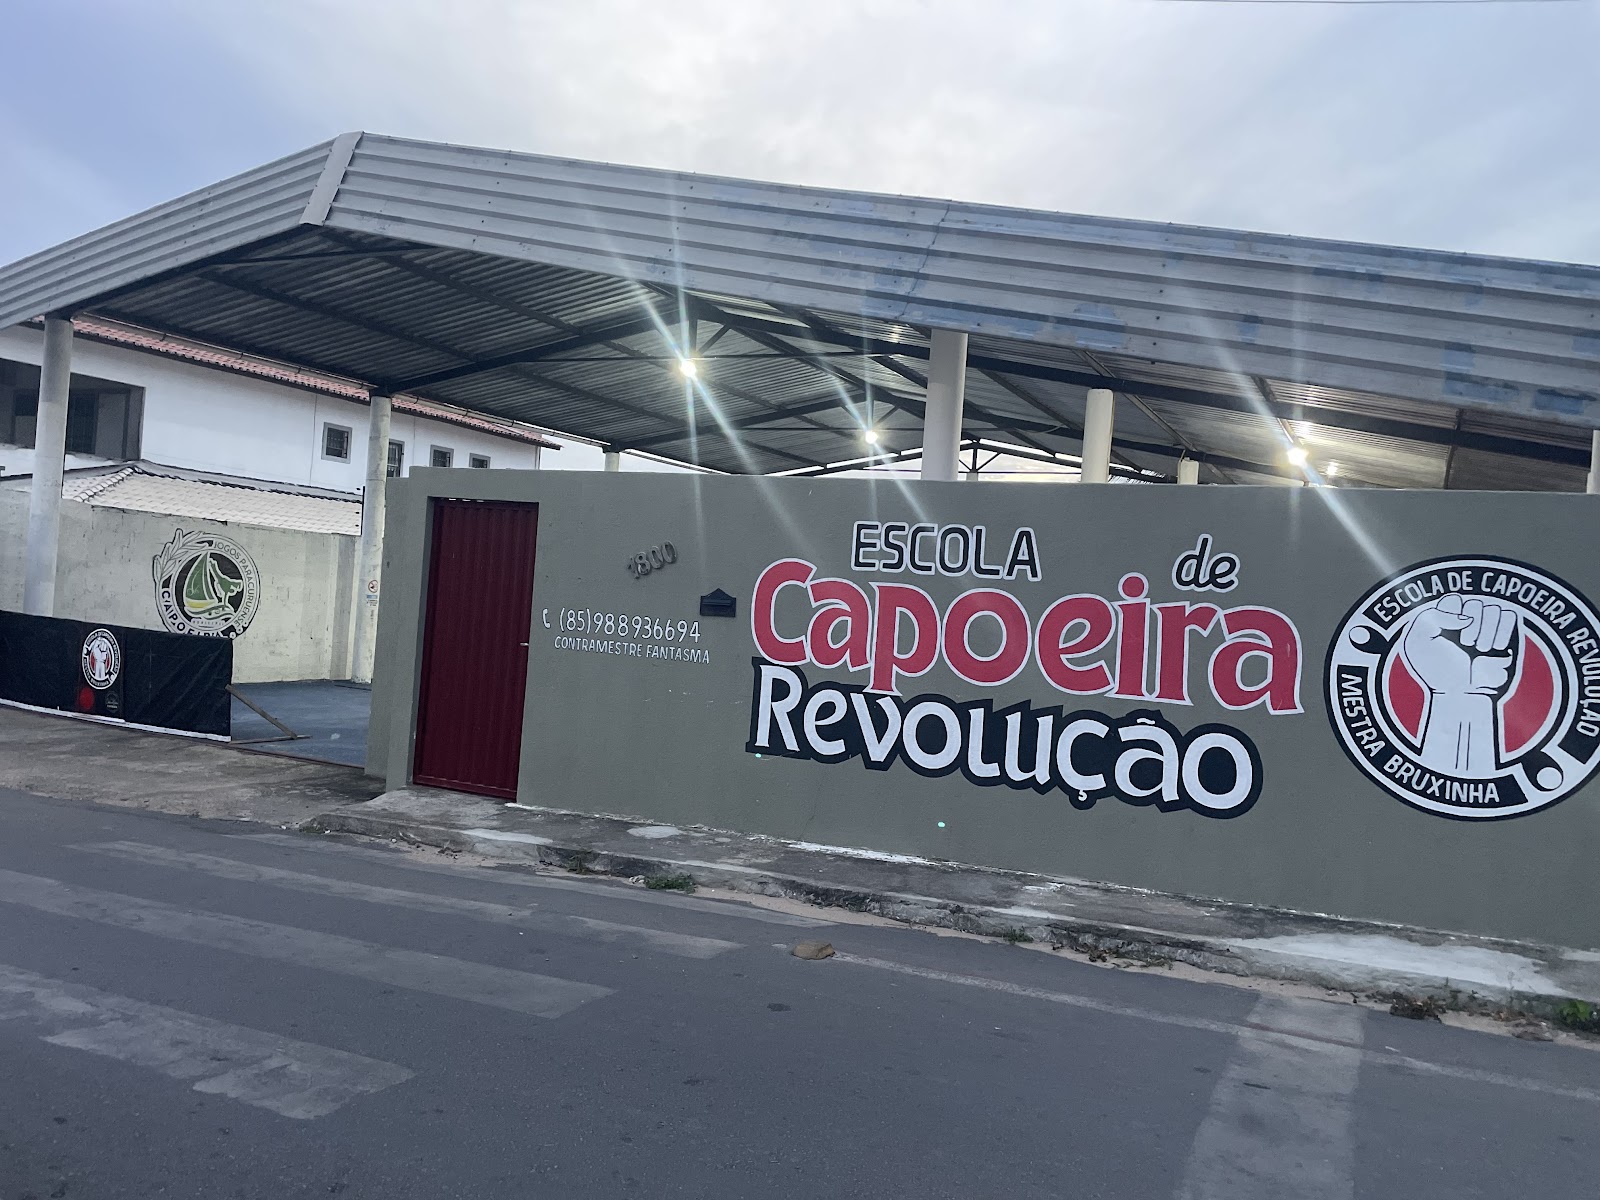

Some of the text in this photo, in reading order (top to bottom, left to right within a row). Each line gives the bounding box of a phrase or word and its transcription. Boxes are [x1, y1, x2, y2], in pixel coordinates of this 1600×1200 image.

[214, 542, 241, 560] JOGOS
[851, 521, 1240, 591] ESCOLA de
[1373, 574, 1445, 623] ESCOLA
[1447, 571, 1474, 591] DE
[1480, 571, 1577, 630] CAPOEIRA
[554, 636, 710, 664] CONTRAMESTRE FANTASMA
[751, 558, 1304, 715] Capoeira
[753, 663, 1254, 811] Revolução
[1341, 673, 1500, 804] MESTRA BRUXINHA
